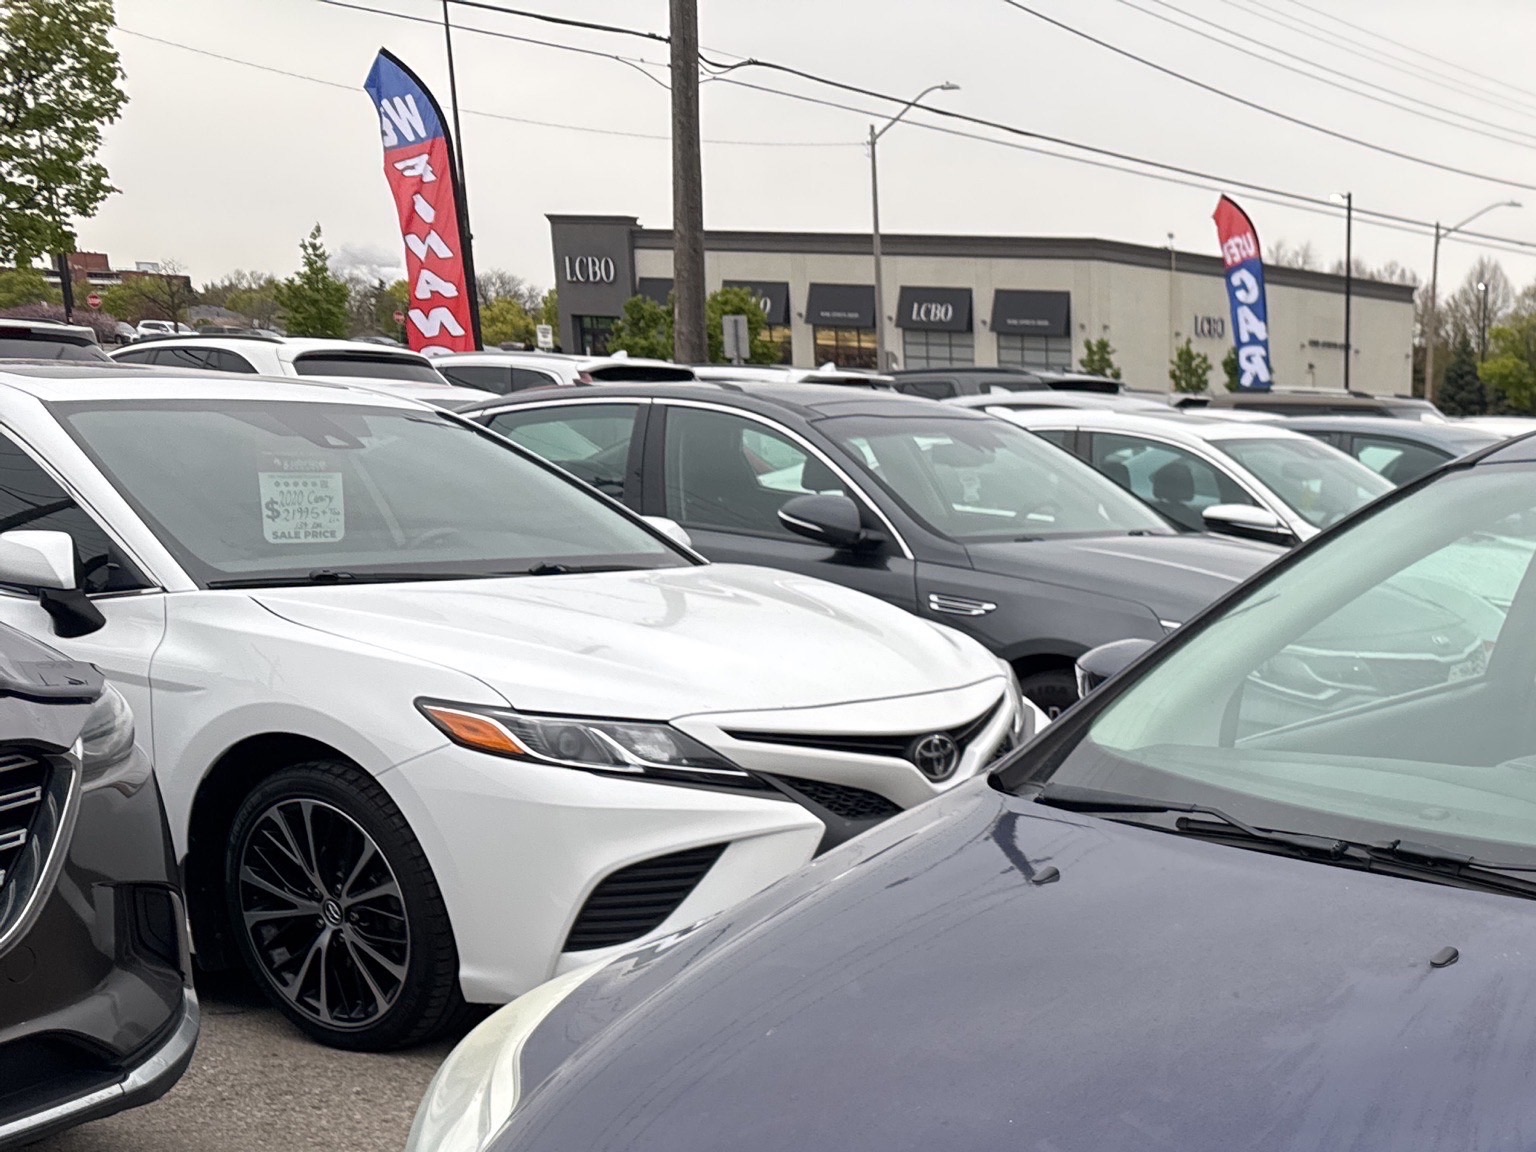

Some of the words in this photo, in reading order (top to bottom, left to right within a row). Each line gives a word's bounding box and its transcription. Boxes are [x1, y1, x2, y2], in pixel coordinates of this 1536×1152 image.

[564, 255, 616, 284] LCBO
[911, 302, 953, 323] LCBO
[1194, 314, 1226, 339] LCBO
[271, 530, 301, 540] SALE
[304, 529, 337, 540] PRICE
